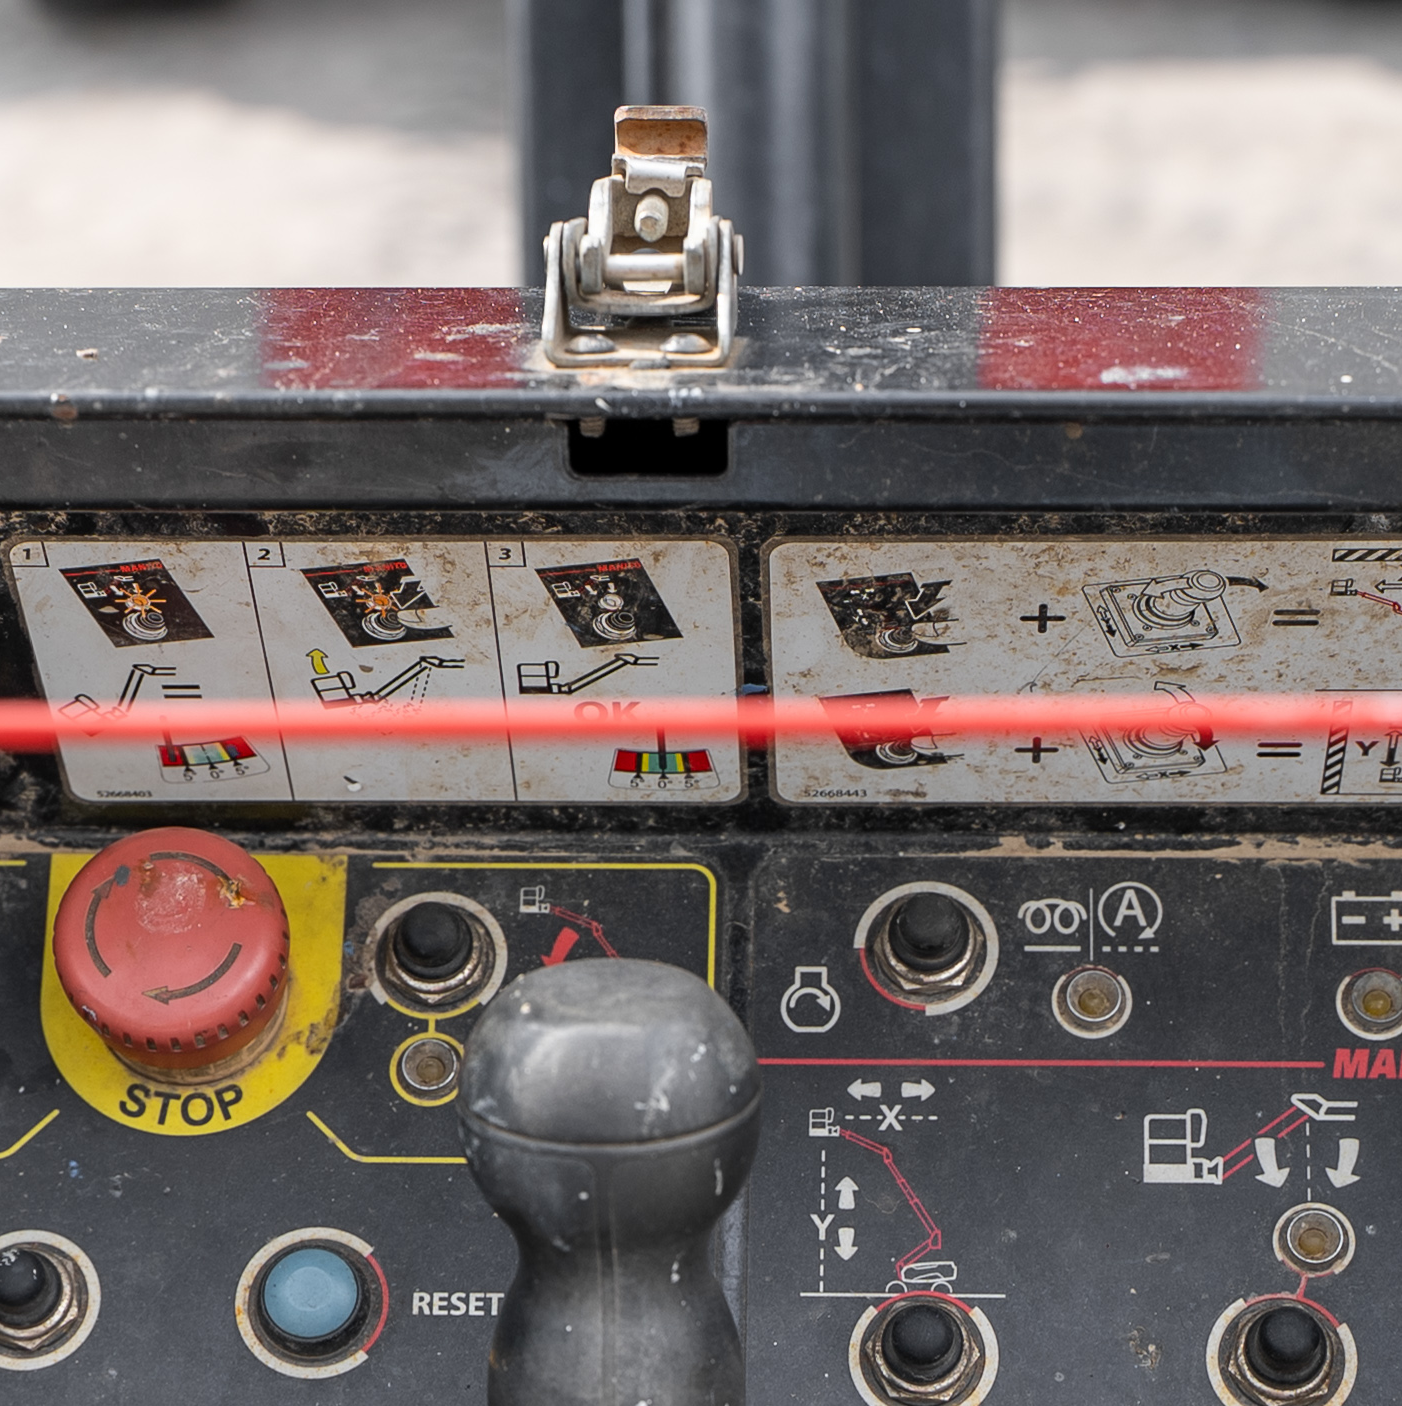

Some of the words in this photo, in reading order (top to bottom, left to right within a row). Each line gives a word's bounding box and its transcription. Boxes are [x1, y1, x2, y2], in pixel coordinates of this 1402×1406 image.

[23, 548, 32, 560] 1
[257, 548, 271, 561] 2
[498, 548, 512, 560] 3
[573, 701, 642, 724] OK
[1355, 740, 1380, 756] Y
[118, 1083, 244, 1127] STOP
[878, 1104, 903, 1131] X
[810, 1213, 835, 1240] Y
[411, 1291, 505, 1316] RESET
